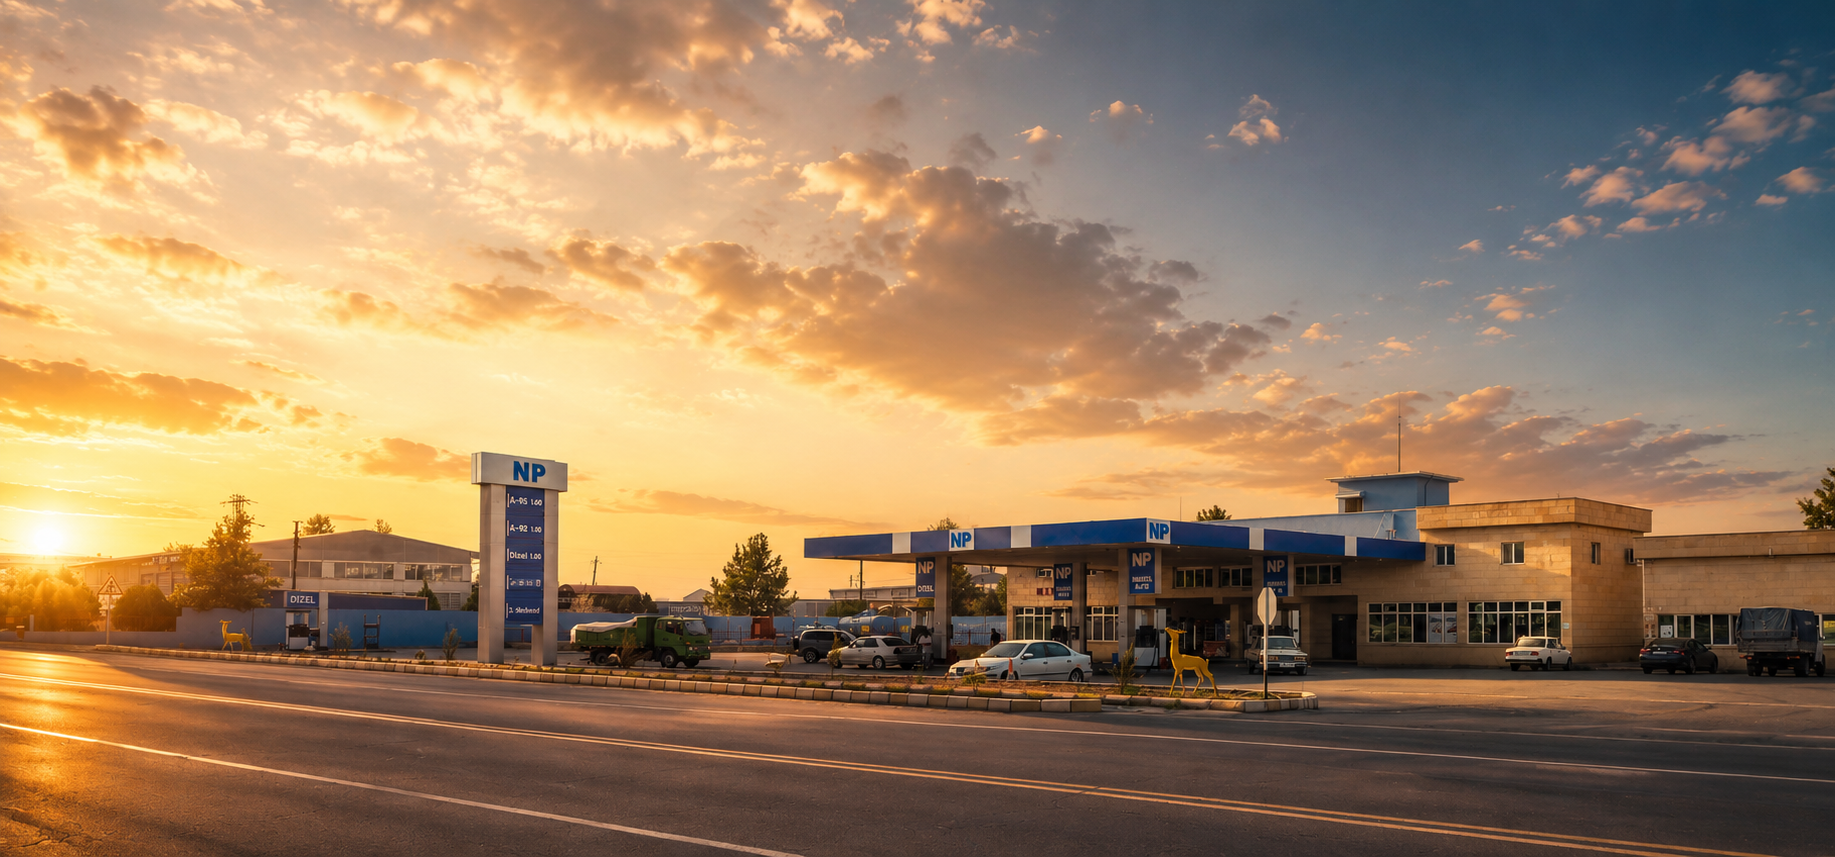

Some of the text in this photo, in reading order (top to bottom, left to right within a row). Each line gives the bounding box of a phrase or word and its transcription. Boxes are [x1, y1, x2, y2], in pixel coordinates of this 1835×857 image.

[513, 460, 546, 483] NP
[509, 524, 528, 533] A-92
[1149, 522, 1170, 540] NP
[950, 531, 972, 548] NP
[1132, 552, 1152, 567] NP
[1267, 559, 1285, 573] NP
[917, 561, 934, 574] NP
[1055, 567, 1072, 579] NP
[290, 595, 316, 604] DIZEL
